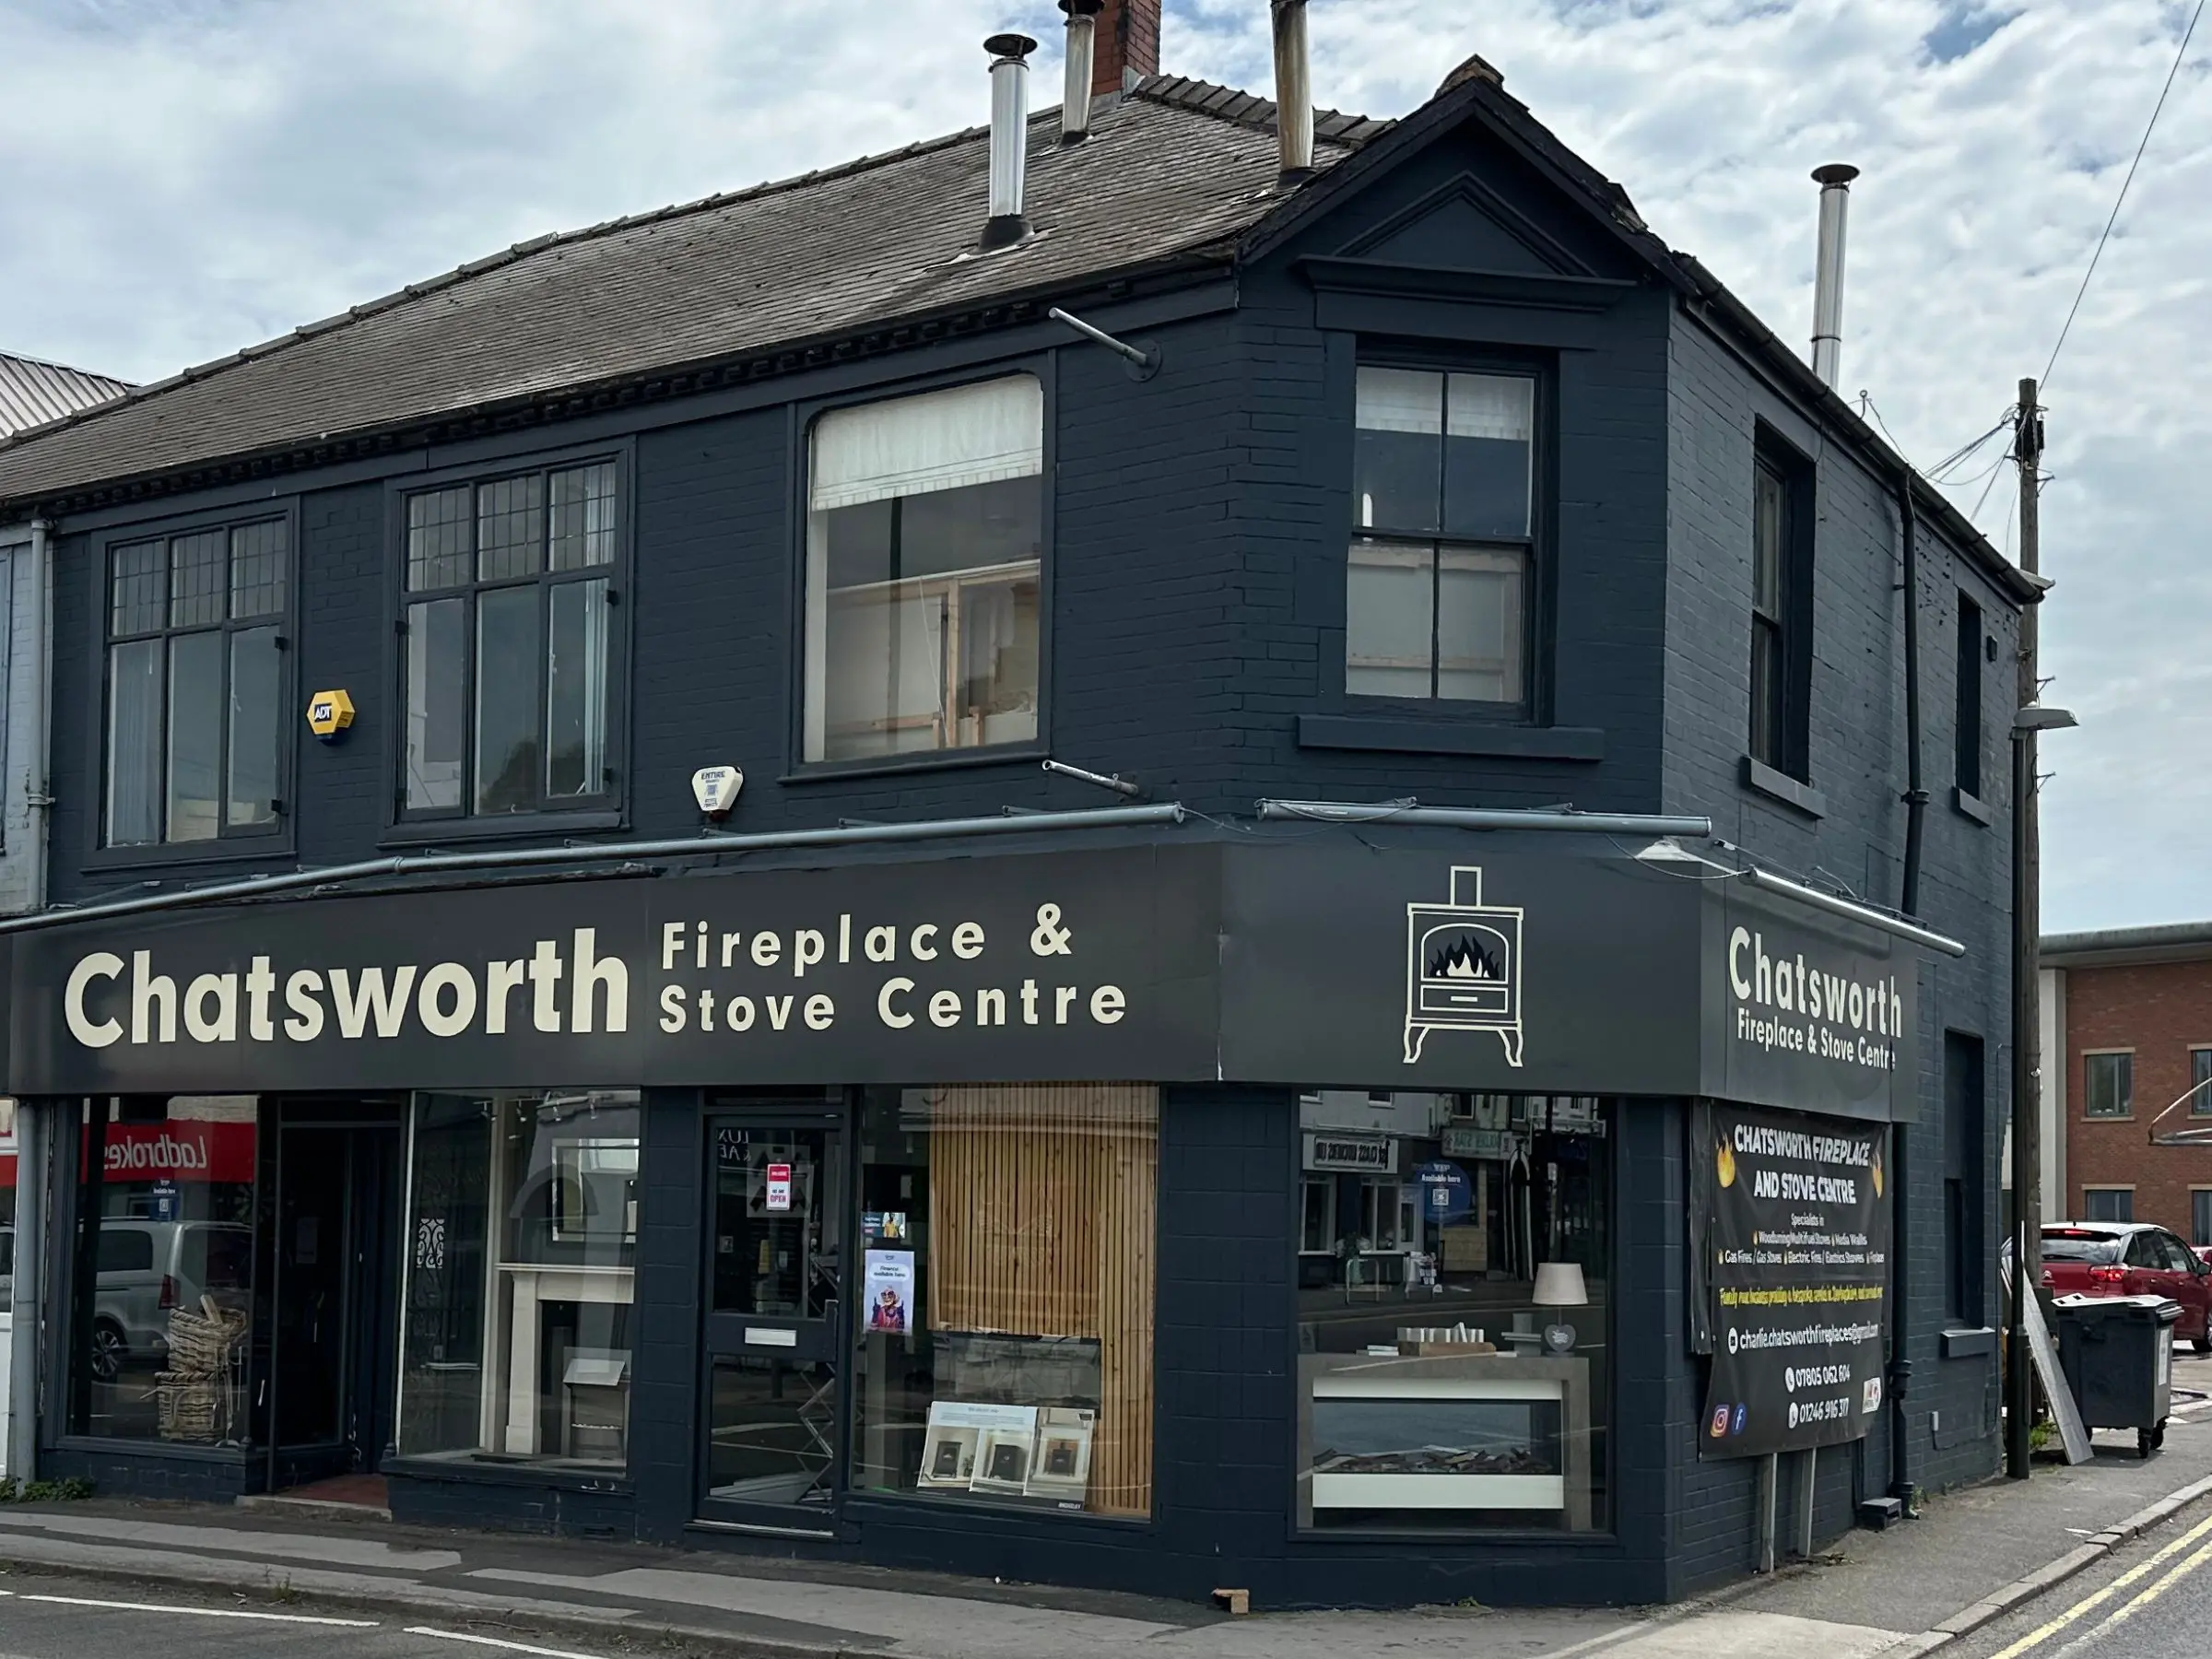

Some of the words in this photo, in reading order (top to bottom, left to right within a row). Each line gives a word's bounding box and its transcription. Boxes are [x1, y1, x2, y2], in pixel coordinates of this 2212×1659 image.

[314, 705, 333, 720] ADT
[661, 913, 986, 978] Fireplace
[1030, 902, 1073, 957] &
[64, 926, 629, 1049] Chatsworth
[659, 983, 836, 1034] Stove
[877, 976, 1127, 1030] Centre
[1729, 925, 1902, 1039] Chatsworth
[1737, 1006, 1804, 1053] Fireplace
[1807, 1023, 1818, 1054] &
[1820, 1026, 1854, 1063] Stove
[1735, 1124, 1812, 1160] CHATSWORTH
[1812, 1136, 1871, 1167] FIREPLACE
[1754, 1171, 1779, 1198] AND
[1781, 1172, 1817, 1202] STOVE
[1817, 1176, 1857, 1204] CENTRE
[1795, 1366, 1822, 1387] 07805
[1822, 1364, 1838, 1384] 062
[1799, 1400, 1824, 1423] 01246
